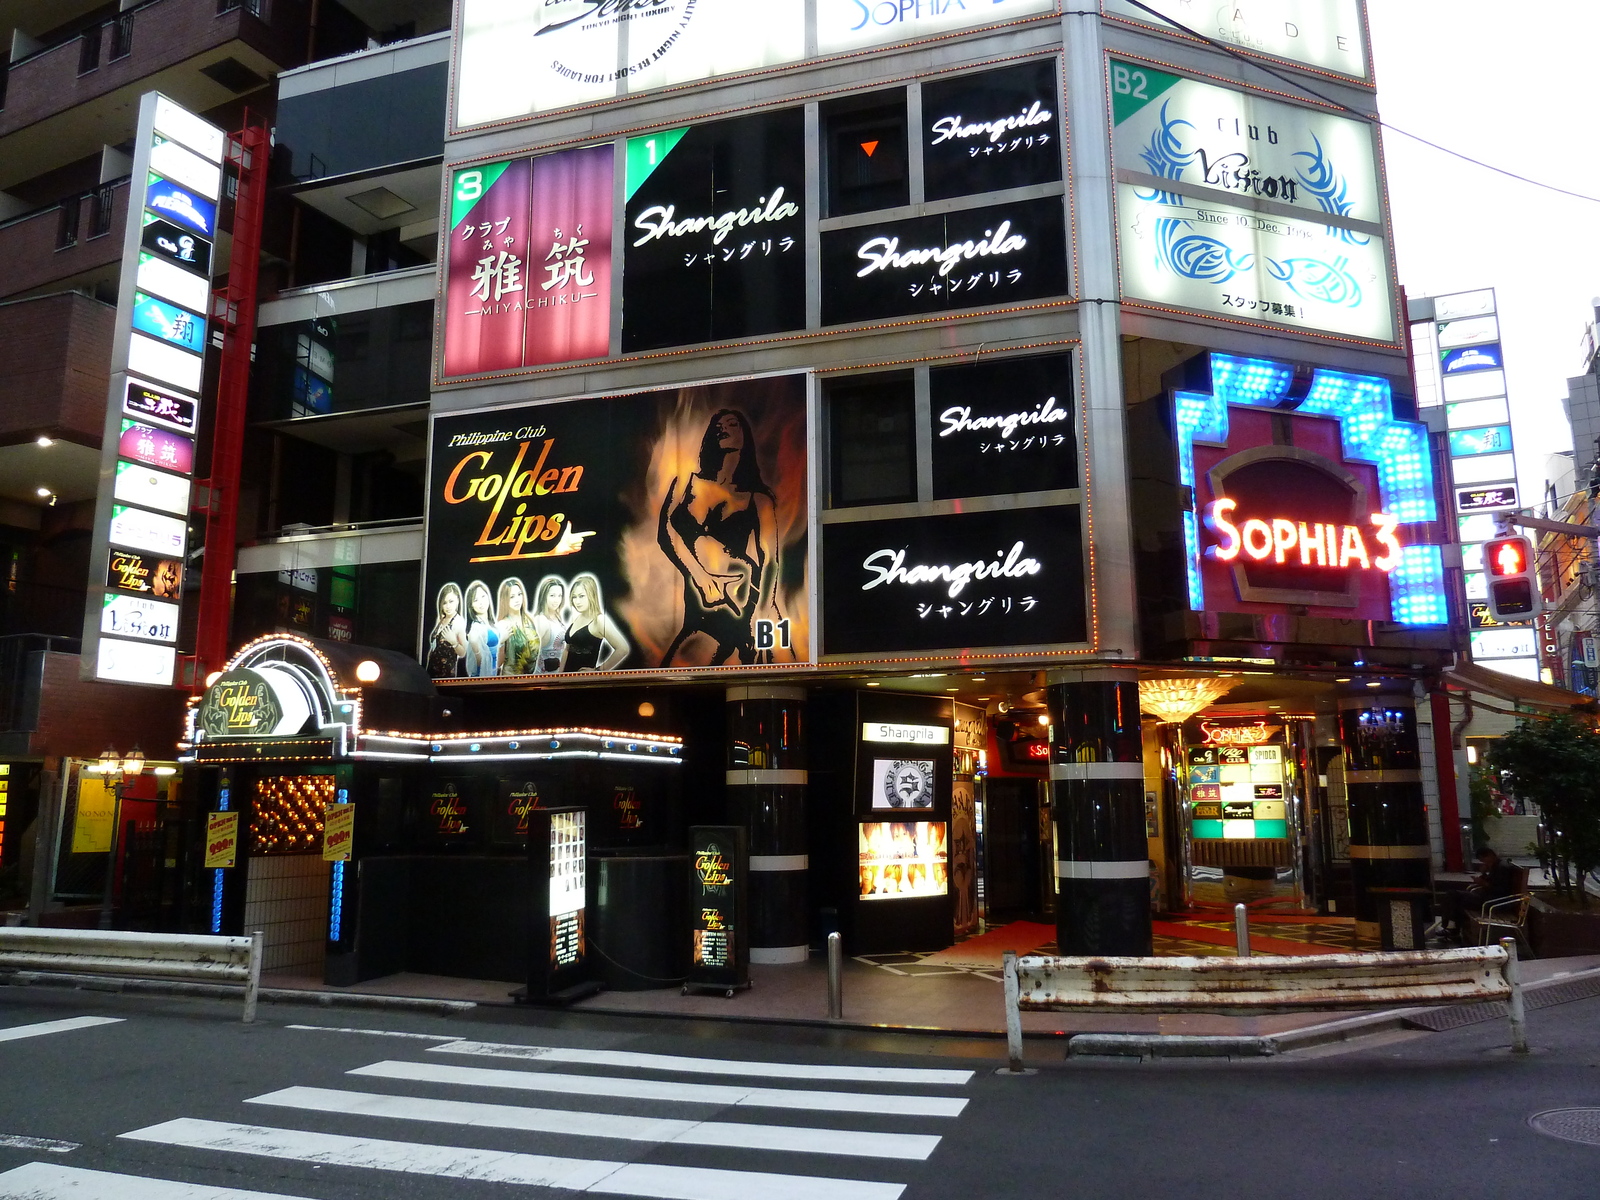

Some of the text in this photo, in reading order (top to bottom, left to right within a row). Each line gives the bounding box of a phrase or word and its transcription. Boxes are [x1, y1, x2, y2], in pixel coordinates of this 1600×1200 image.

[581, 5, 676, 31] TOKYO NIGHT LUXURY
[651, 29, 681, 62] NIGHT
[550, 60, 583, 82] LADIES
[584, 73, 605, 84] FOR
[607, 57, 651, 82] RESORT
[1113, 66, 1149, 100] B2
[930, 100, 1053, 146] Shangrila
[644, 140, 657, 165] 1
[968, 134, 1051, 159] シャングリラ
[457, 170, 483, 201] 3
[1195, 148, 1300, 203] Vision
[461, 216, 511, 241] クラブ
[632, 186, 800, 248] Shangrila
[1196, 210, 1229, 225] Since
[1257, 219, 1281, 234] Dec.
[683, 235, 796, 267] シャングリラ
[855, 219, 1028, 279] Shangrila
[469, 237, 595, 302] 雅筑
[907, 269, 1022, 297] シャングリラ
[480, 291, 583, 316] MIYACHIKU
[172, 313, 194, 344] 翔
[939, 396, 1068, 438] Shangrila
[448, 425, 547, 447] Philippine Club
[979, 433, 1066, 454] シャングリラ
[1483, 430, 1502, 448] 翔
[444, 438, 585, 504] Golden
[473, 502, 566, 558] Lips
[1209, 498, 1402, 571] SOPHIA 3
[111, 557, 149, 577] Golden
[861, 540, 1042, 598] Shangrila
[119, 573, 144, 589] Lips
[916, 595, 1039, 619] シャングリラ
[755, 619, 791, 649] B1
[220, 685, 258, 707] Golden
[228, 707, 253, 727] Lips
[879, 725, 934, 742] Shangrila
[1200, 721, 1266, 744] SOPHIA 3
[1254, 749, 1277, 760] SPIDER
[430, 797, 467, 816] Golden
[613, 792, 641, 810] Golden
[695, 855, 730, 870] Golden
[704, 870, 726, 884] Lips
